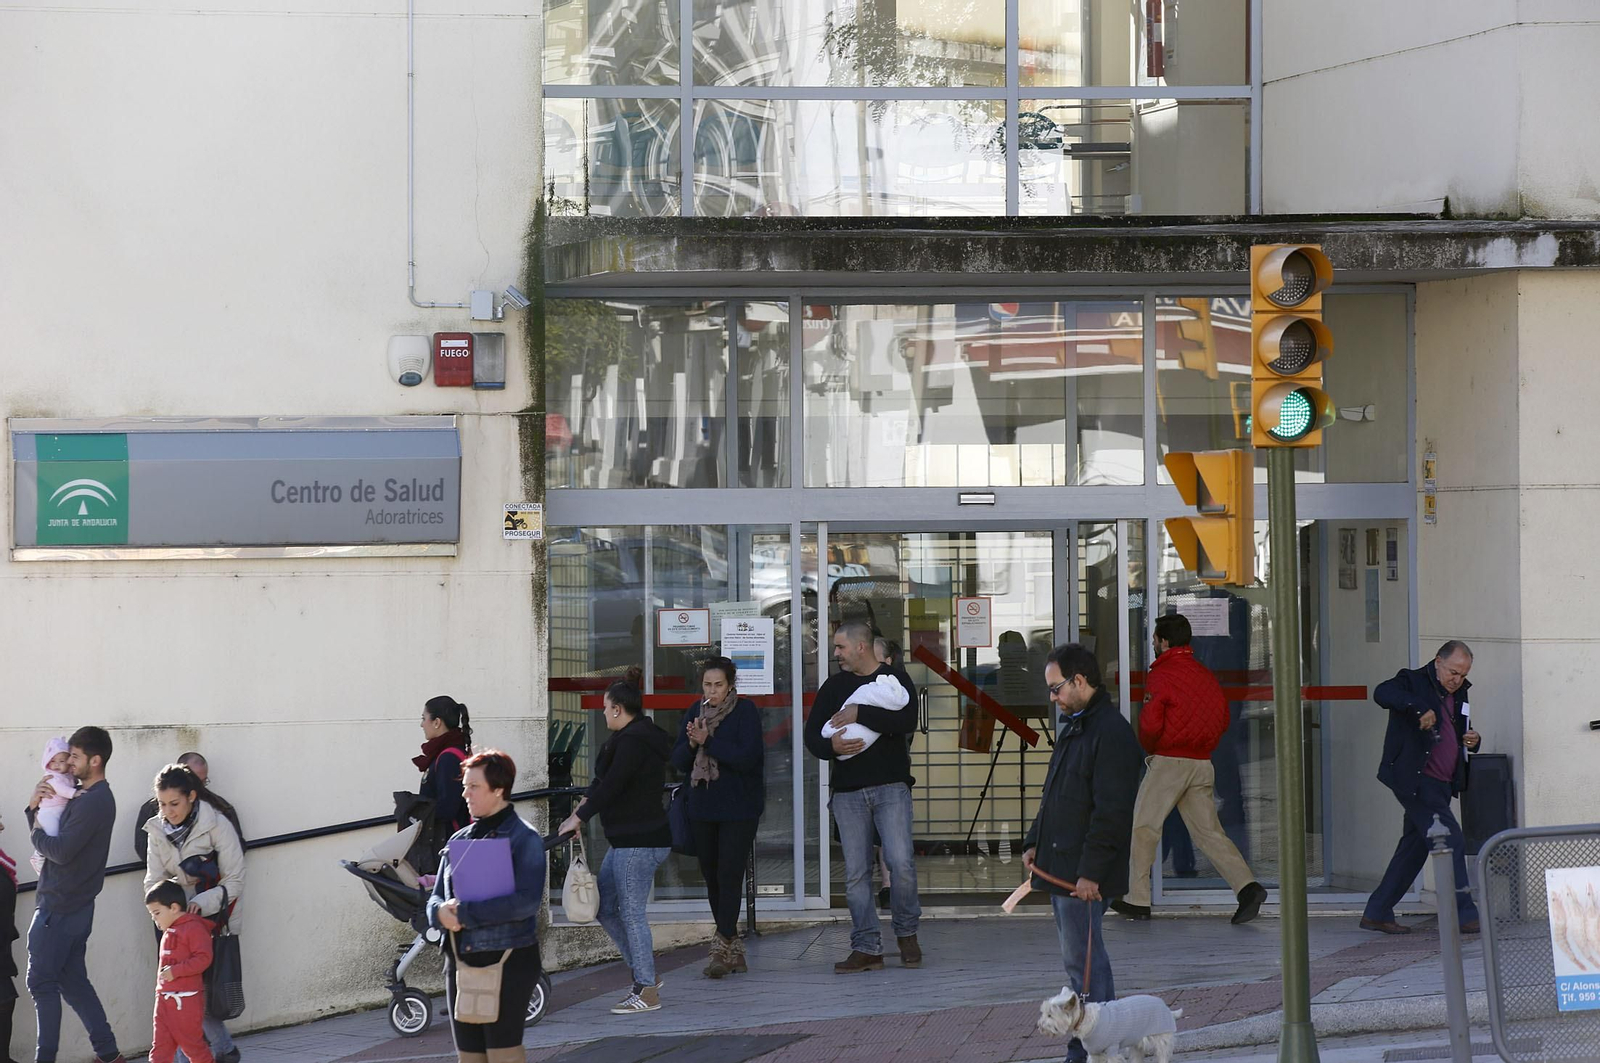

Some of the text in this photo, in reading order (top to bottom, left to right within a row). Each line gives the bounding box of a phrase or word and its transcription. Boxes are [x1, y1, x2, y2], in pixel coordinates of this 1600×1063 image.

[440, 349, 469, 358] FUEGO
[271, 477, 444, 504] Centro de Salud
[365, 508, 444, 525] Adoratrices
[48, 518, 118, 527] JUNTA DE ANDALUCIA
[1560, 982, 1570, 992] C/
[1579, 992, 1596, 1001] 959
